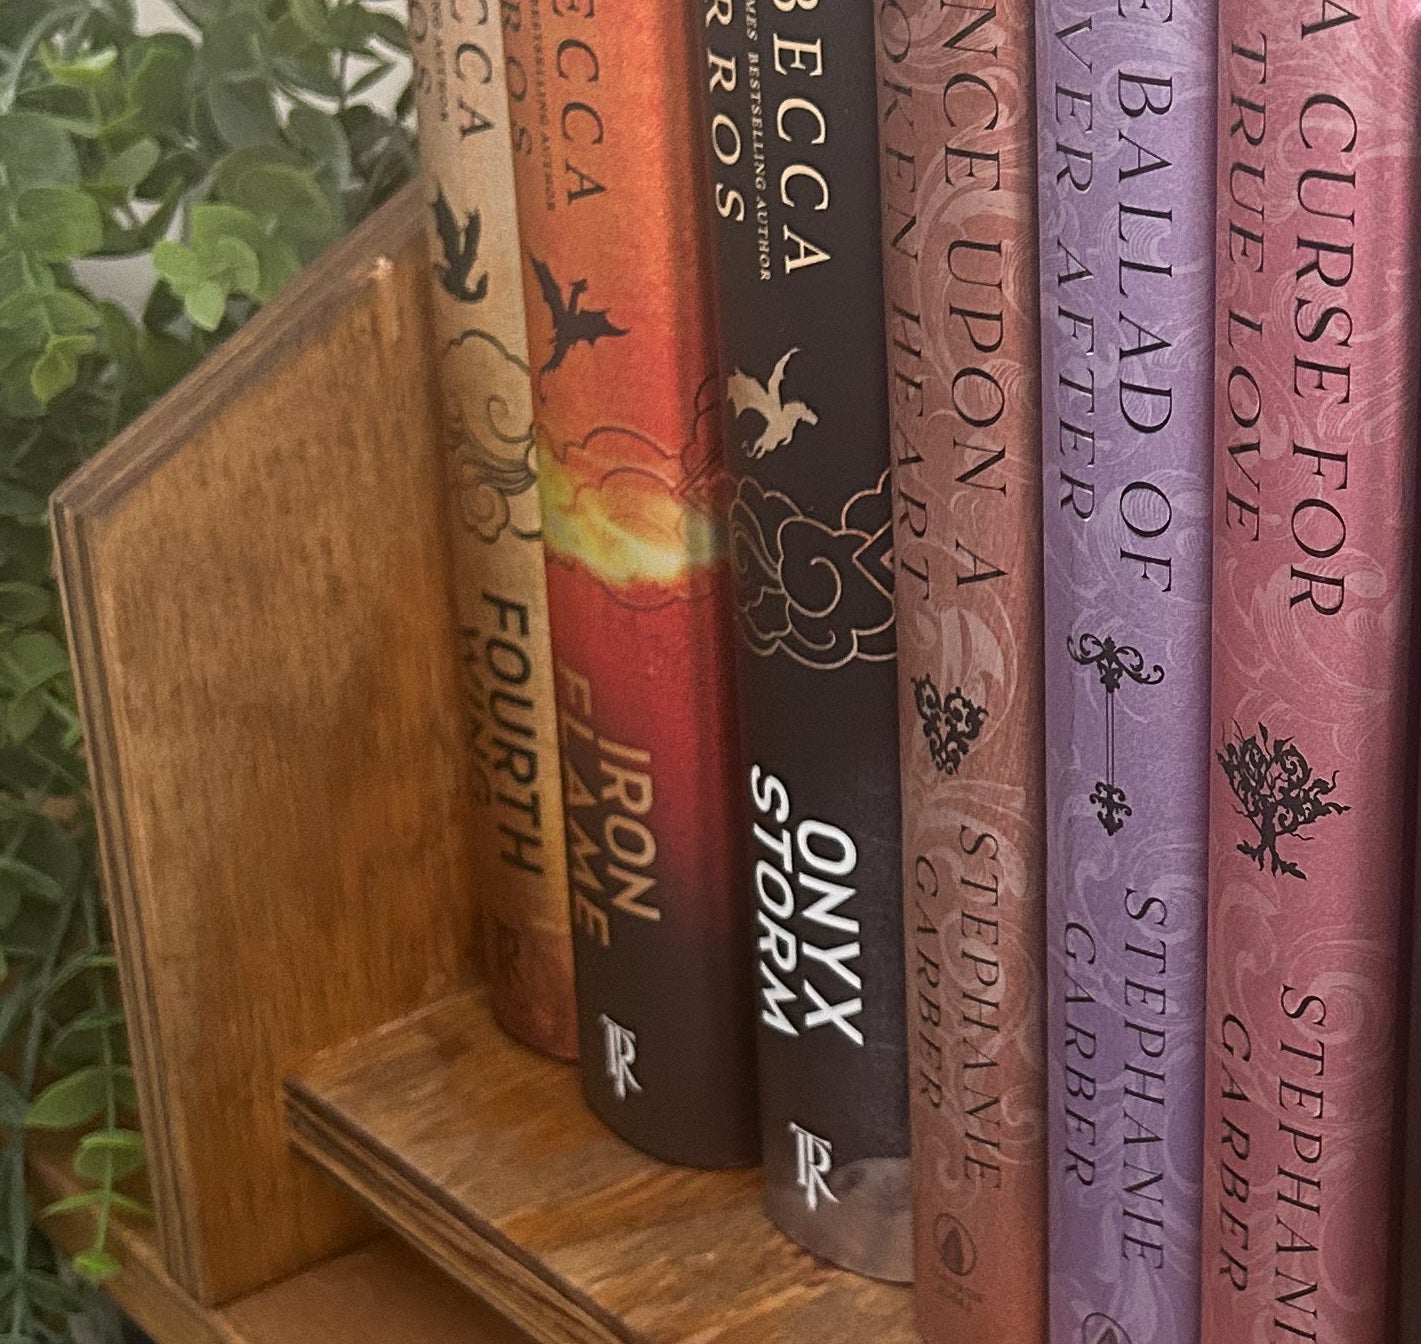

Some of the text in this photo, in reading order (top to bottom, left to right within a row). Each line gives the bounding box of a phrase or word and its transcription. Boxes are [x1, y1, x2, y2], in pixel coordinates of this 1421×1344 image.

[746, 51, 768, 190] BESTSELLING
[754, 195, 773, 282] AUTHOR
[1116, 69, 1174, 435] BALLAD
[1293, 92, 1358, 405] CURSE
[946, 237, 1007, 497] UPON
[1056, 240, 1097, 523] AFTER
[1225, 32, 1268, 543] TRUE LOVE
[891, 300, 931, 601] HEART
[954, 537, 1009, 588] A
[1118, 480, 1174, 592] OF
[1290, 444, 1350, 617] FOR
[482, 590, 545, 875] FOURTH
[556, 664, 610, 947] FLAME
[598, 738, 662, 923] IRON
[751, 763, 800, 1038] STORM
[796, 817, 865, 1047] ONYX
[913, 854, 945, 1112] GARBER
[957, 822, 1002, 1191] STEPHANIE
[1062, 920, 1100, 1189] GARBER
[1121, 887, 1168, 1271] STEPHANIE
[1217, 1012, 1253, 1292] GARBER
